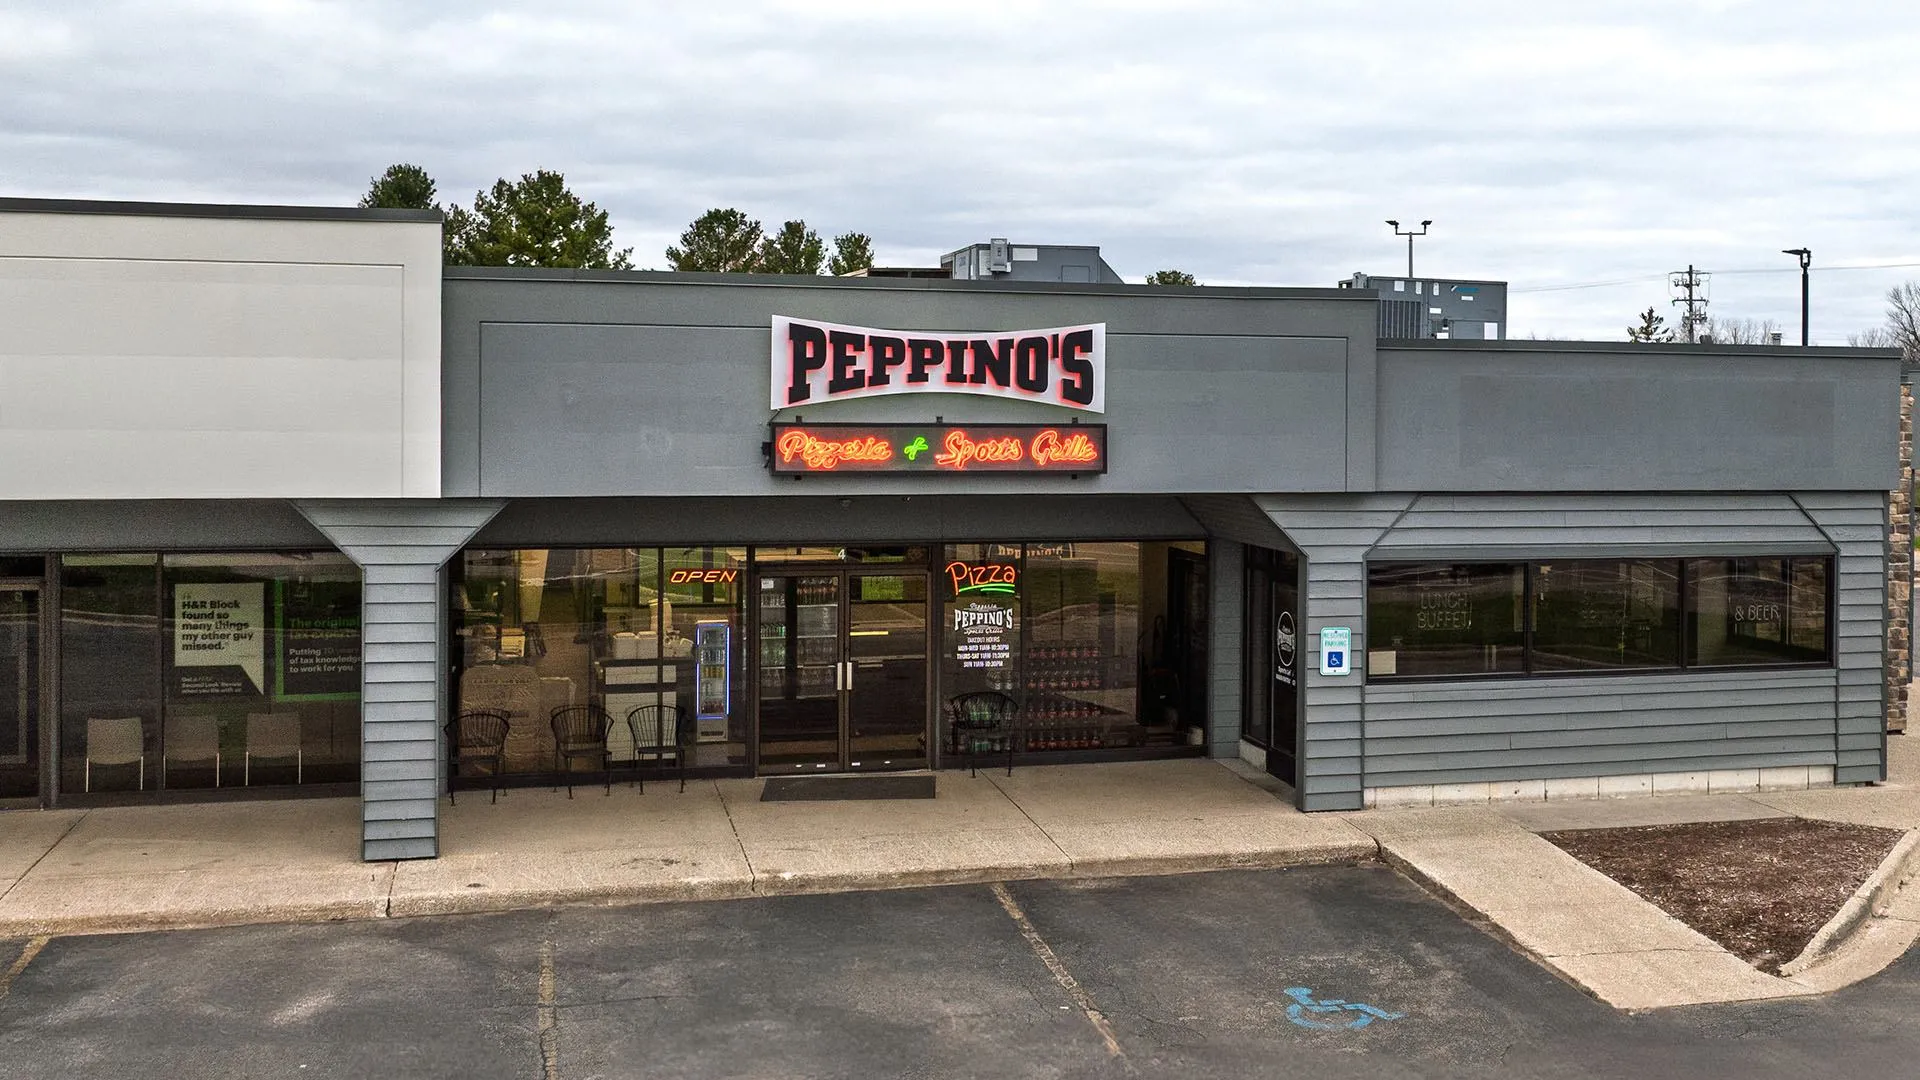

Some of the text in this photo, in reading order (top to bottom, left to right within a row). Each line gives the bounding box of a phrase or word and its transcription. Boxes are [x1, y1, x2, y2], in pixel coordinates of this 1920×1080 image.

[788, 322, 1094, 405] PEPPINO'S
[778, 430, 892, 468] Pizzeria
[935, 430, 1023, 469] Sports
[1031, 430, 1098, 466] Grille
[837, 548, 846, 560] 4
[670, 570, 738, 583] OPEN
[945, 561, 1016, 596] Pizza
[182, 600, 241, 609] H&R Block
[1420, 592, 1469, 609] LUNCH
[182, 610, 229, 620] found so
[1734, 604, 1781, 621] & BEER
[289, 618, 312, 628] The
[954, 607, 1013, 631] PEPPINO'S
[1417, 611, 1468, 629] BUFFET
[182, 620, 250, 632] many things
[182, 631, 254, 642] my other guy
[289, 647, 321, 657] Putting
[289, 657, 299, 665] of
[289, 665, 299, 673] to
[300, 664, 322, 673] work
[323, 663, 335, 672] for
